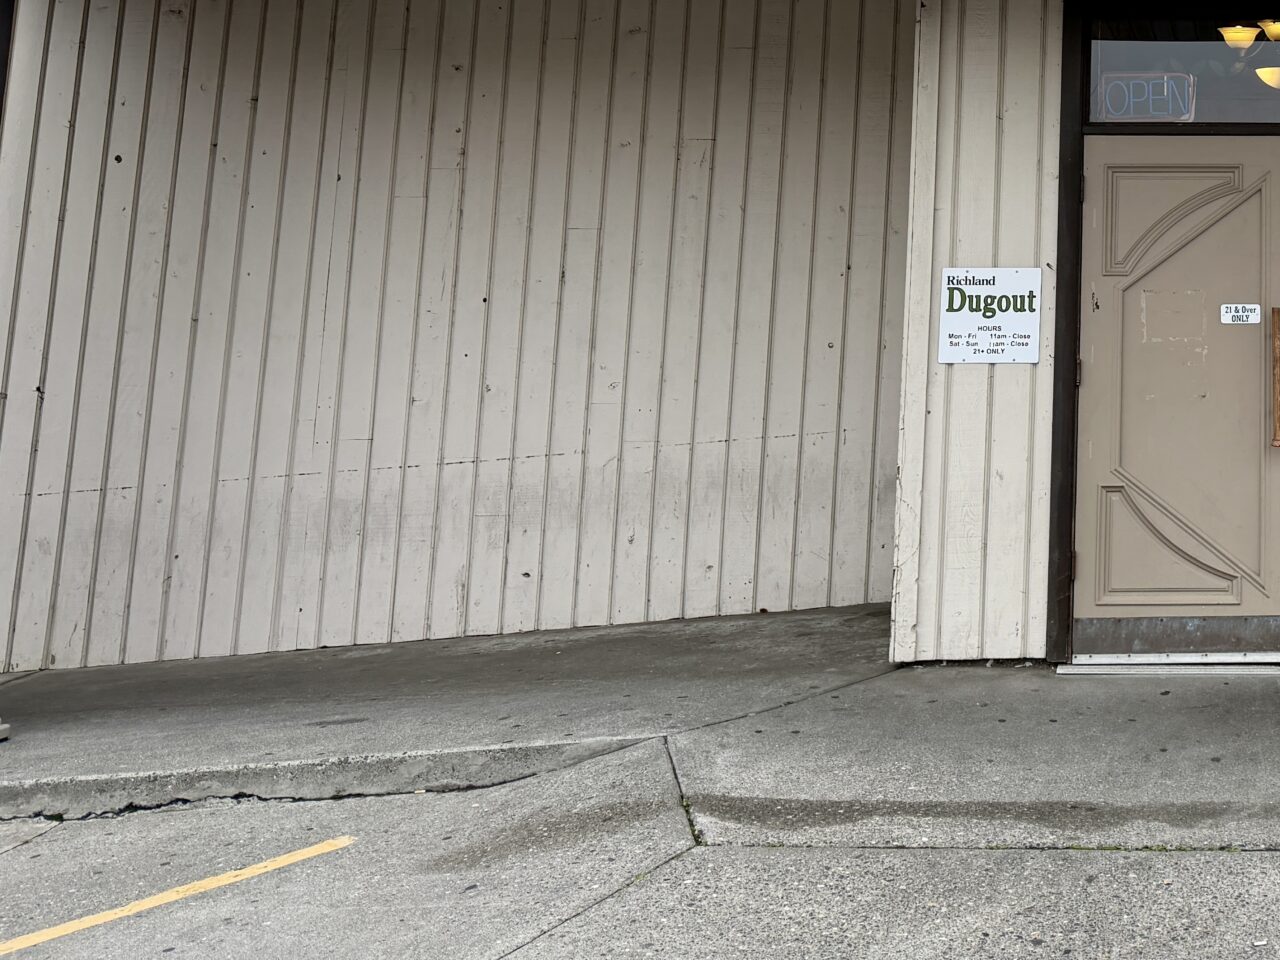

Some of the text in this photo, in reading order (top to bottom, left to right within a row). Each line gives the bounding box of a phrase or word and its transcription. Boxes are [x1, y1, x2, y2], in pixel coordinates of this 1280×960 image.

[1105, 79, 1188, 116] OPEN
[946, 275, 996, 286] Richland
[946, 287, 1036, 319] Dugout
[1225, 305, 1257, 314] 21 & Over
[1231, 314, 1250, 323] ONLY
